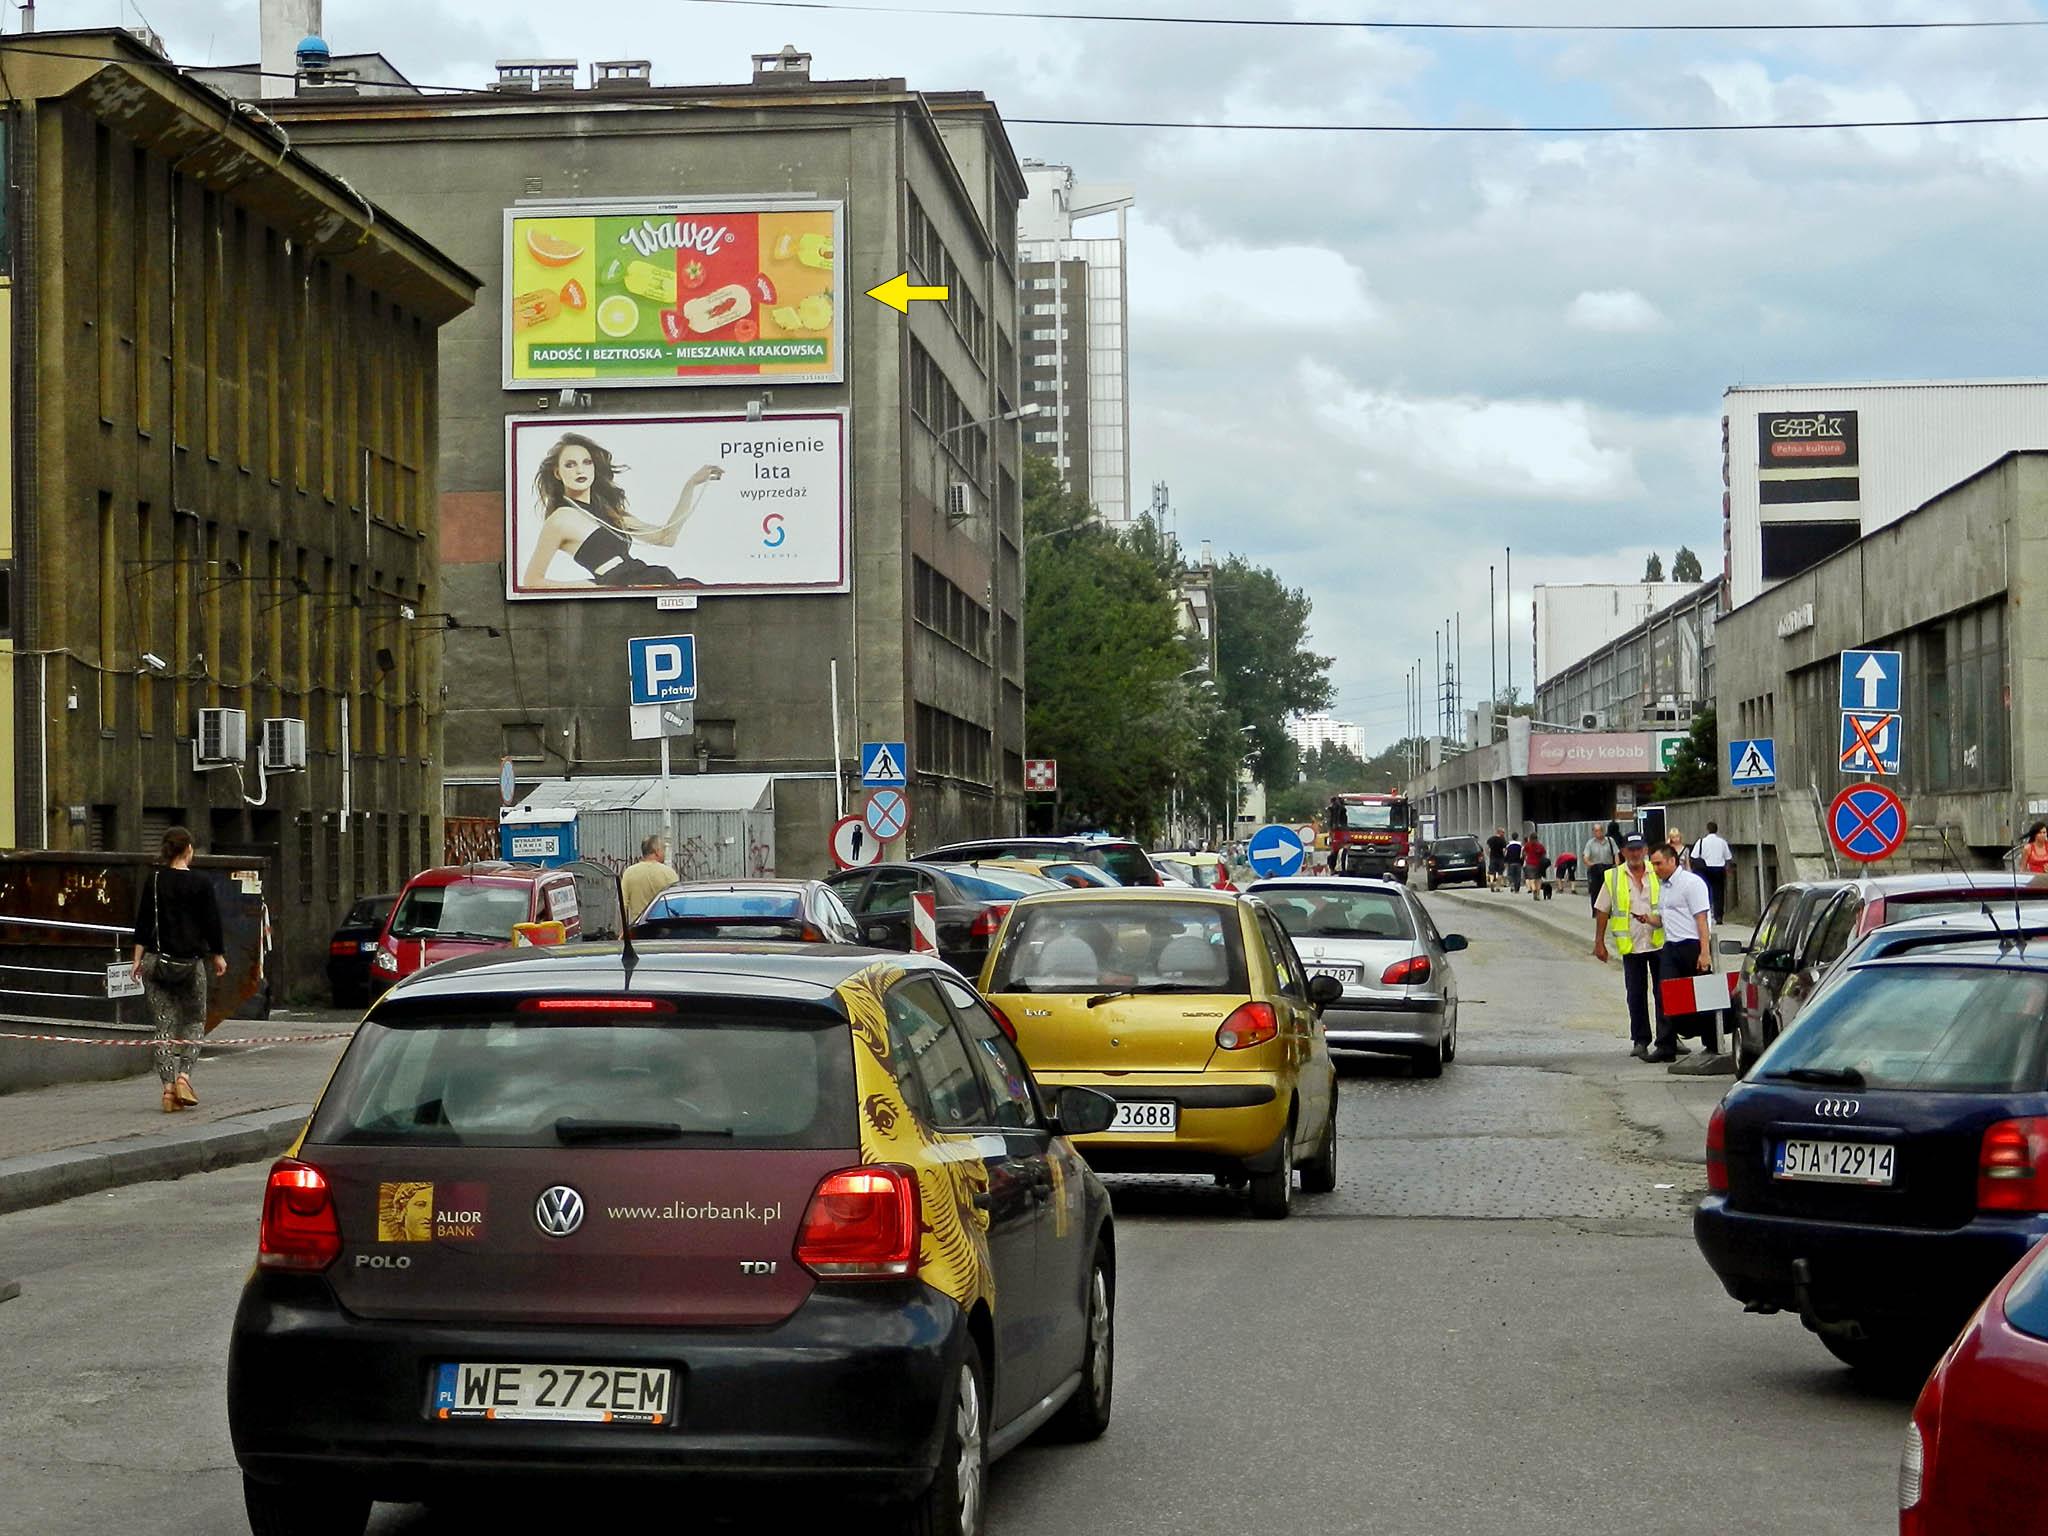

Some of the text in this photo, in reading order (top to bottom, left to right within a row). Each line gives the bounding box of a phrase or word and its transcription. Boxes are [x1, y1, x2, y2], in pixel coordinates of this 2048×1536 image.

[620, 219, 727, 256] Wawel
[533, 347, 582, 360] RADOŚĆ
[585, 349, 590, 360] I
[593, 348, 662, 360] BEZTROSKA
[676, 346, 745, 358] MIESZANKA
[749, 345, 824, 356] KRAKOWSKA
[720, 437, 824, 459] pragnienie
[1806, 443, 1841, 454] kultura
[755, 463, 790, 479] lata
[740, 486, 807, 500] wyprzedaż
[661, 598, 684, 607] ams
[645, 643, 682, 696] P
[1567, 745, 1594, 760] city
[1599, 744, 1644, 759] kebab
[1121, 1105, 1170, 1126] 3688
[1786, 1142, 1892, 1177] STA 12914
[436, 1211, 482, 1223] ALIOR
[608, 1201, 782, 1225] www.aliorbank.pl
[437, 1225, 475, 1237] BANK
[355, 1255, 411, 1269] POLO
[740, 1261, 776, 1274] TDI
[440, 1391, 453, 1402] PL
[464, 1367, 666, 1412] WE 272EM
